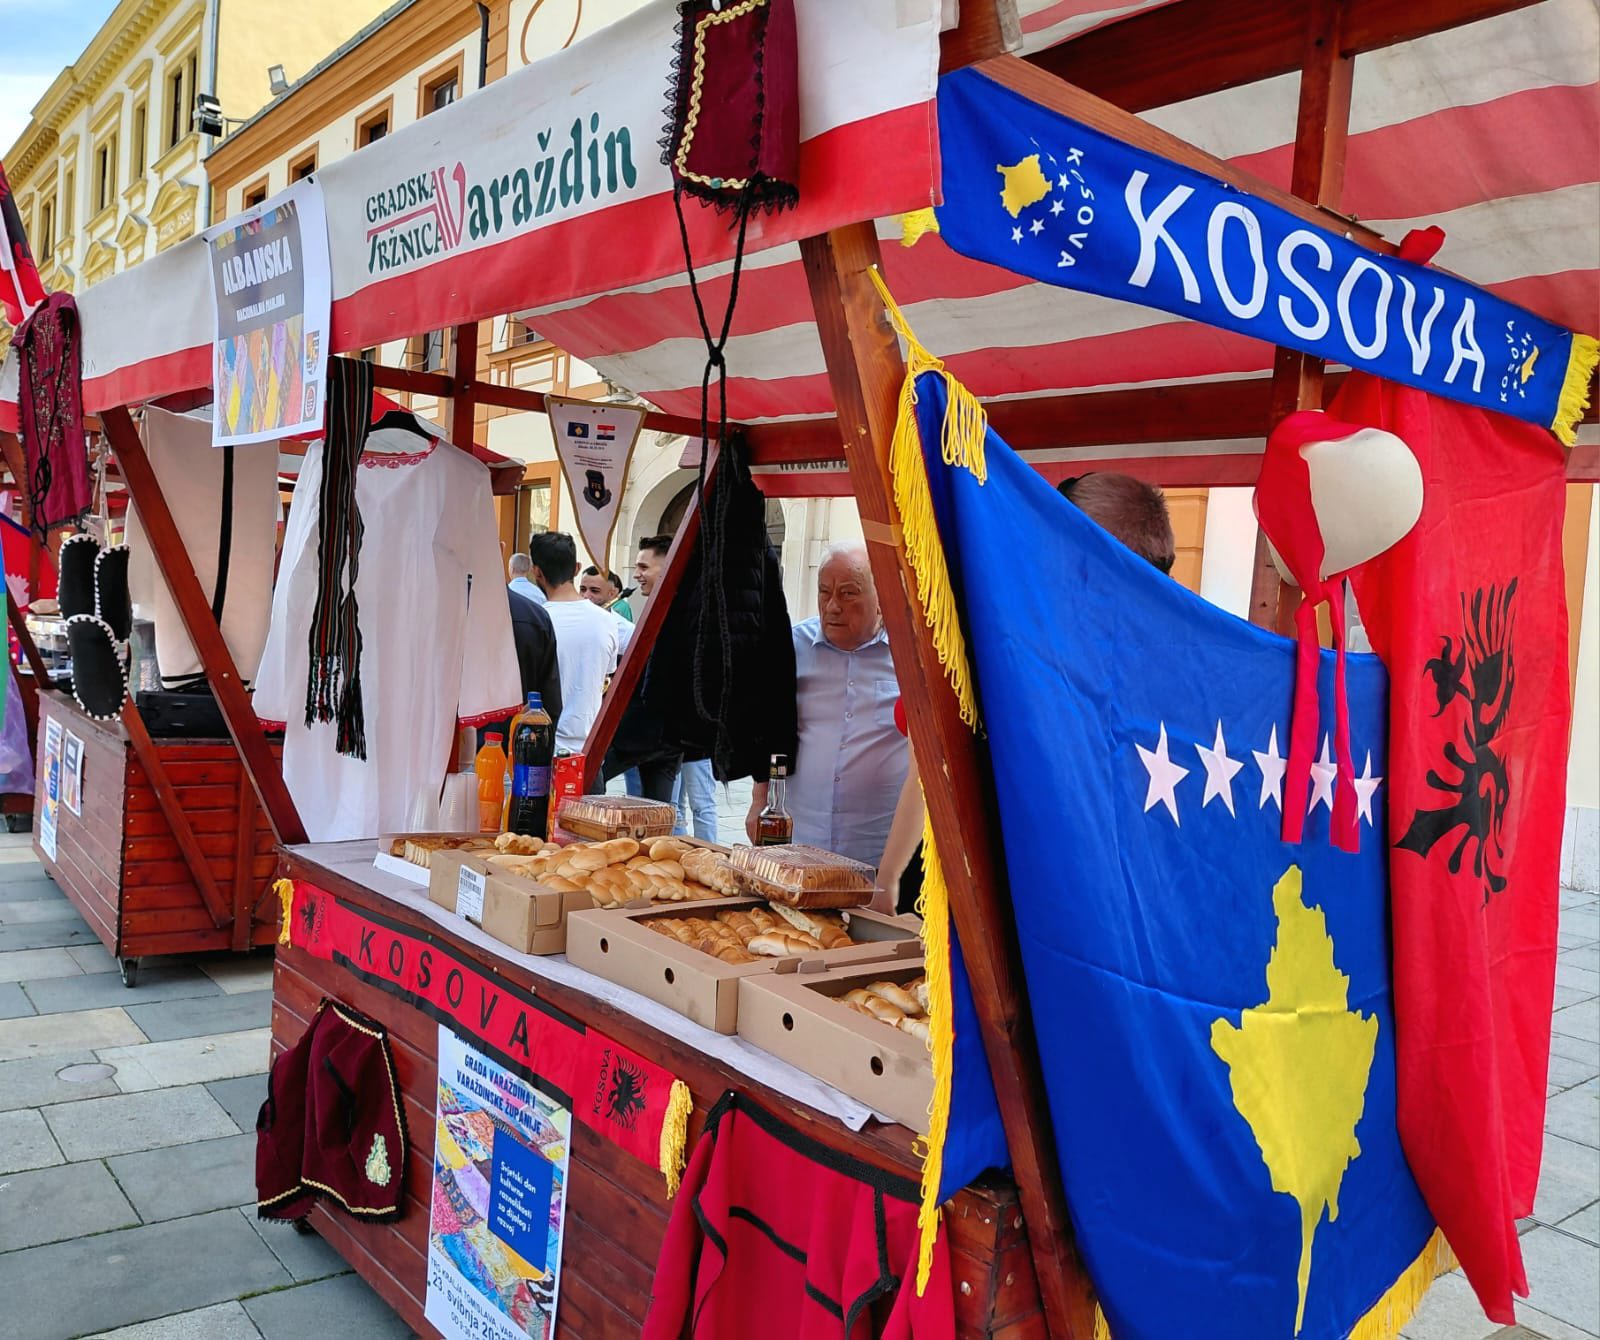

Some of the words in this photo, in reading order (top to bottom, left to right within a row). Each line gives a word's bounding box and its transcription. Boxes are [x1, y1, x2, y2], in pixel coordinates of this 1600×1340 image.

[366, 171, 437, 223] GRADSKA
[432, 111, 637, 251] Varaždin
[1057, 147, 1095, 268] KOSOVA
[222, 235, 293, 296] ALBANSKA
[367, 222, 444, 275] TRŽNICA
[1124, 169, 1486, 393] KOSOVA
[358, 926, 531, 1058] KOSOVA
[456, 1069, 504, 1113] VARAŽDINSKE
[504, 1098, 542, 1136] ŽUPANIJE
[464, 1054, 488, 1079] GRADA
[489, 1069, 533, 1107] VARAŽDINA
[592, 1050, 612, 1115] KOSOVA
[499, 1190, 532, 1219] raznolikosti
[500, 1161, 523, 1185] Svjetski
[523, 1178, 536, 1194] dan
[500, 1173, 524, 1199] kulturne
[497, 1216, 516, 1237] razvoj
[432, 1271, 445, 1295] 23.
[447, 1289, 479, 1331] svibnja
